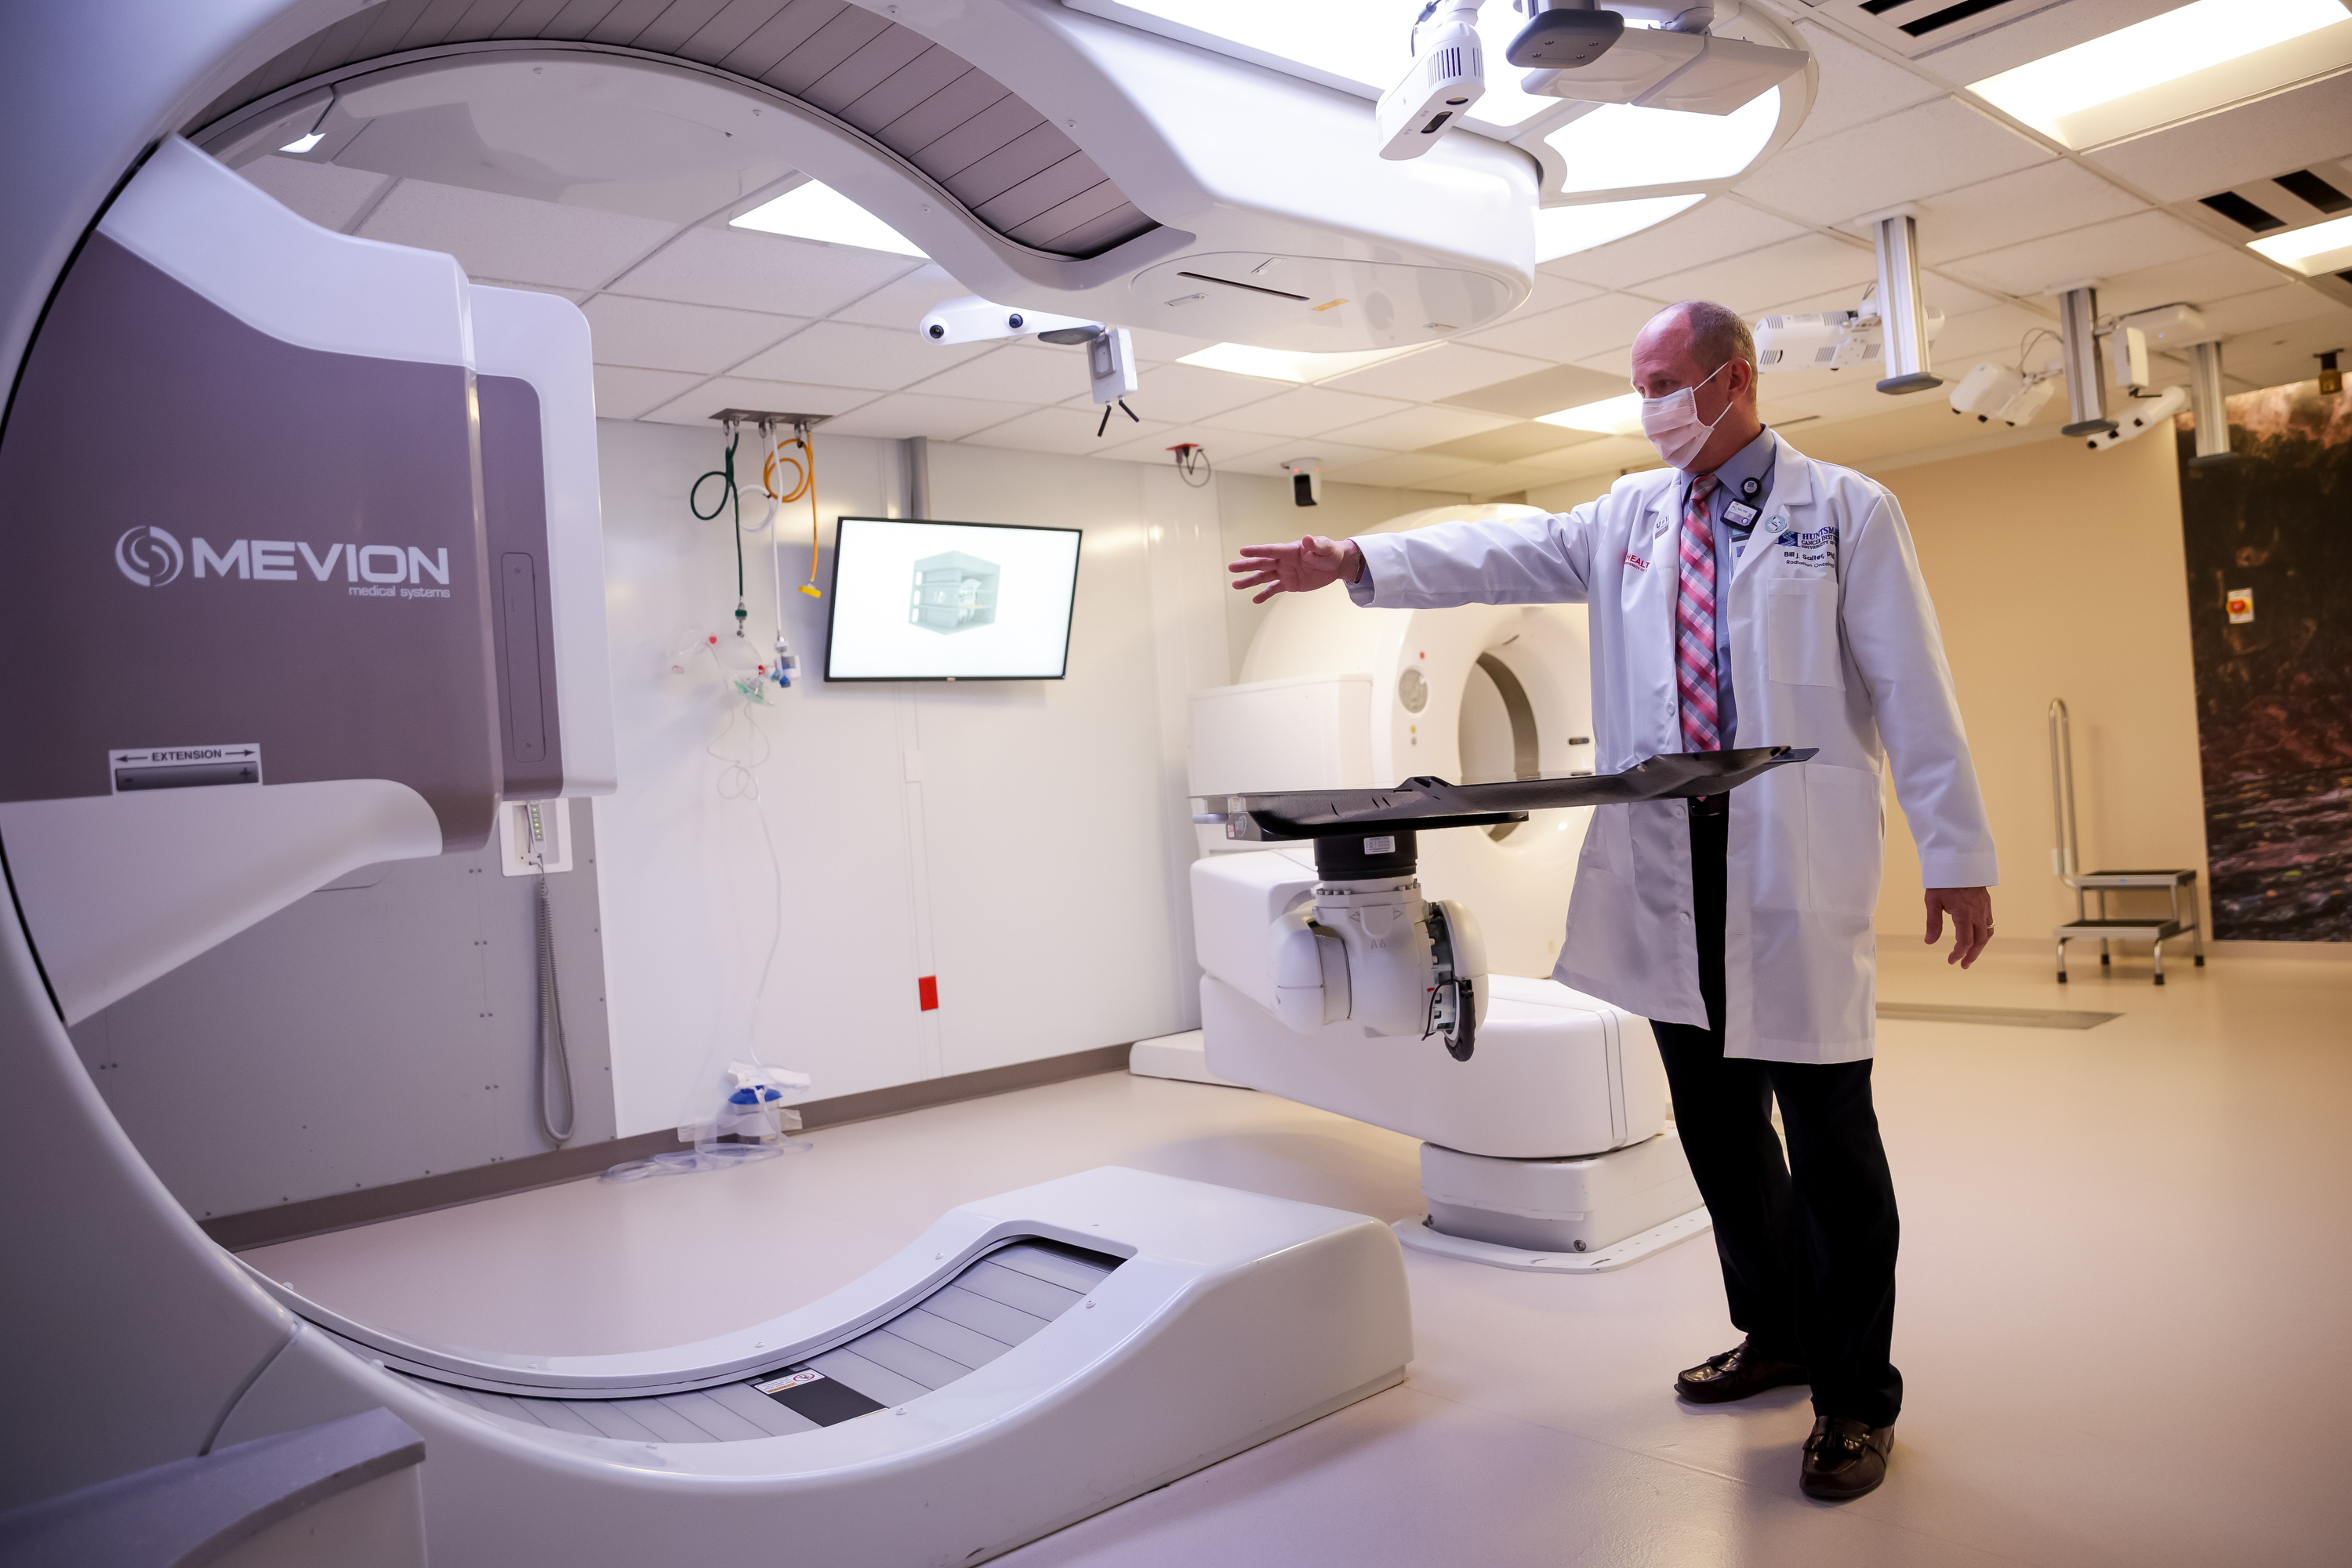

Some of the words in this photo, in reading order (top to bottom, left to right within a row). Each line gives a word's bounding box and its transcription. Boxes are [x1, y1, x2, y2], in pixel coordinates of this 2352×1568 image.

[191, 537, 450, 585] MEVION
[349, 586, 396, 597] medical
[401, 586, 451, 600] systems
[151, 749, 222, 762] EXTENSION
